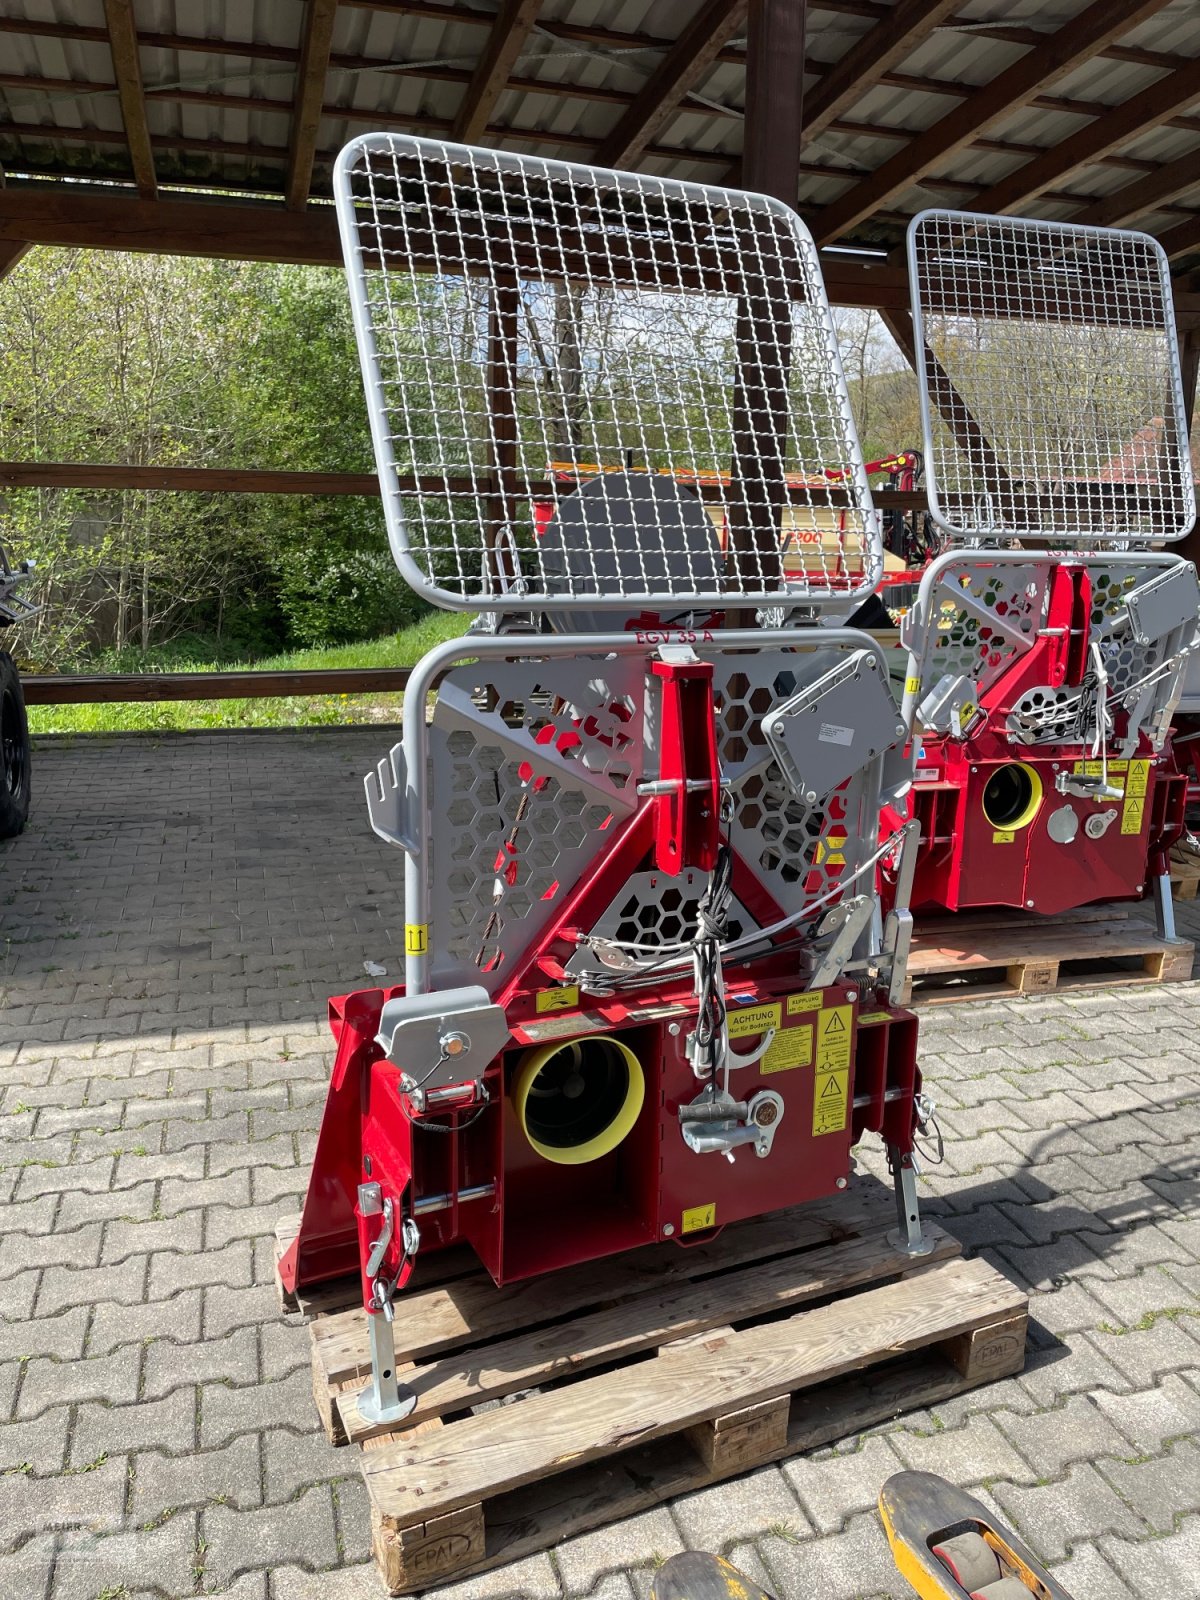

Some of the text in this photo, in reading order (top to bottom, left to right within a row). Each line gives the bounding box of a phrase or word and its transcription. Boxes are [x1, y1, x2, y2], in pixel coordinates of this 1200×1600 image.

[634, 630, 714, 645] EGV 35 A
[733, 1010, 774, 1025] ACHTUNG
[749, 1020, 777, 1030] Bodenzug
